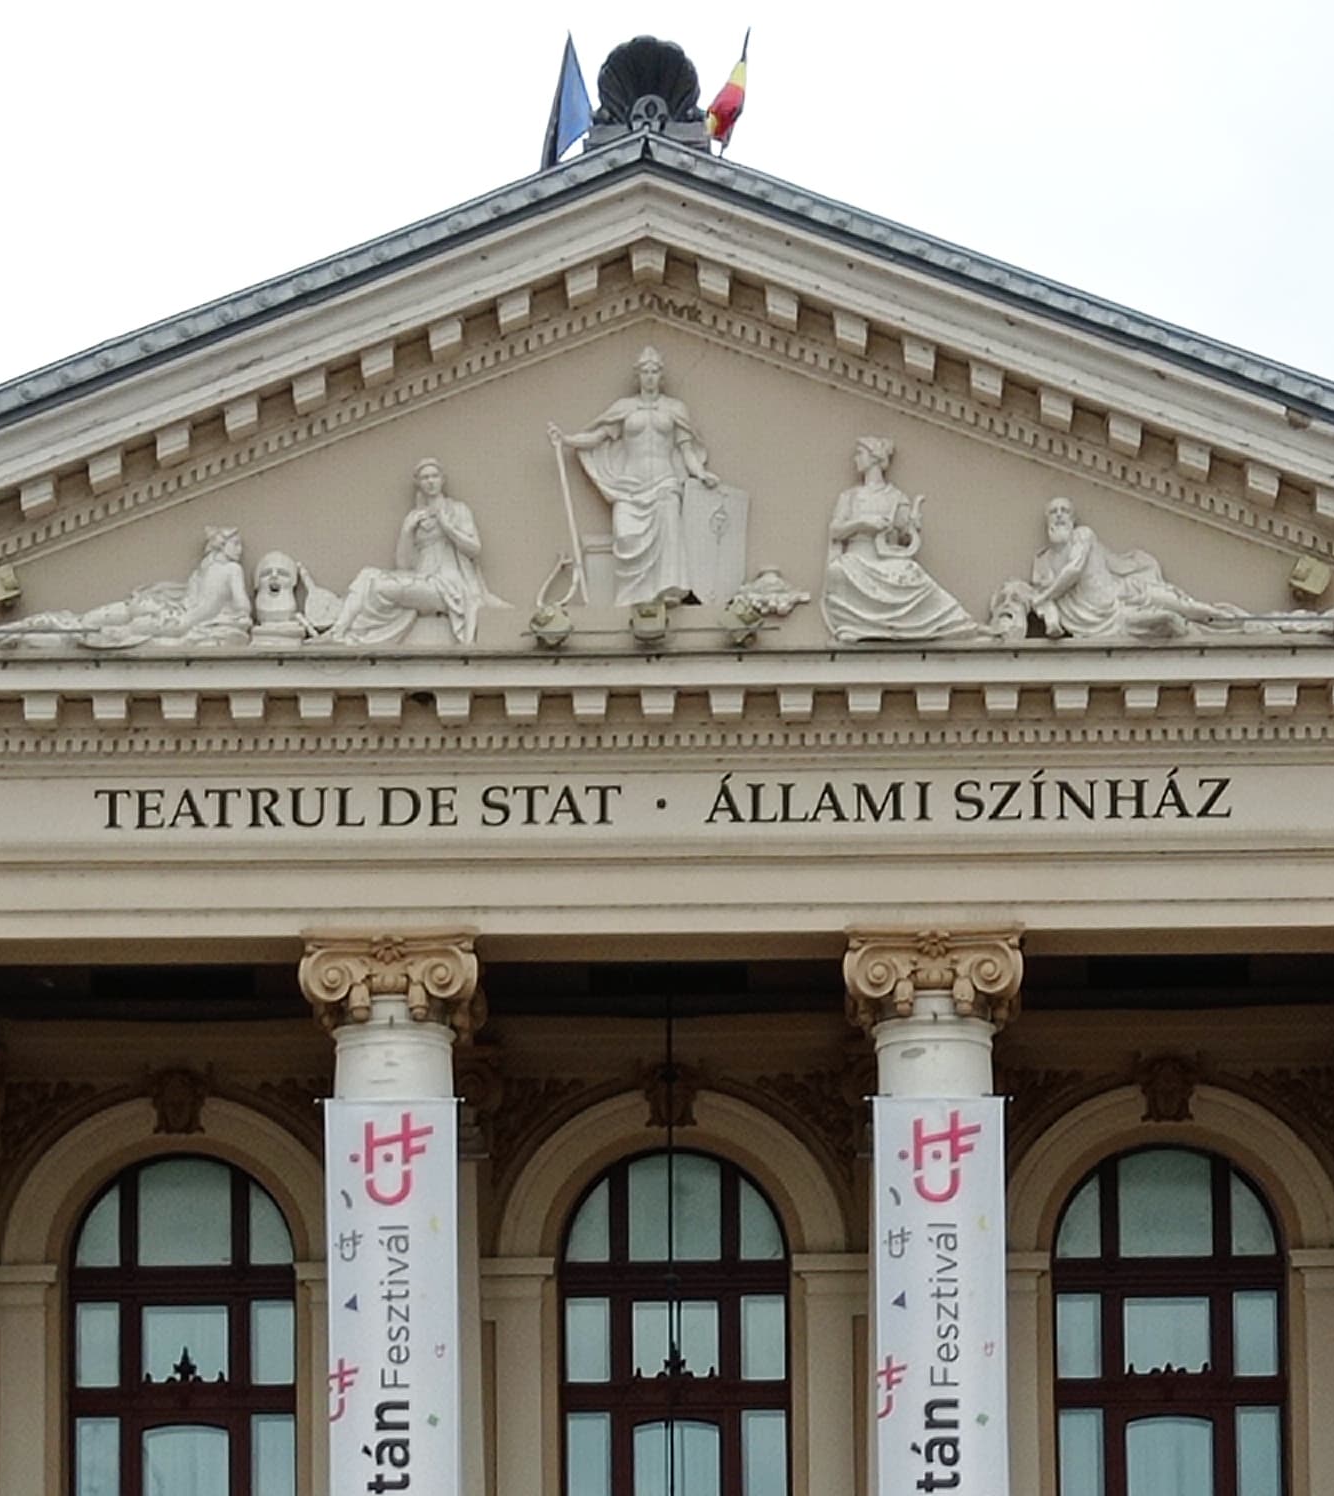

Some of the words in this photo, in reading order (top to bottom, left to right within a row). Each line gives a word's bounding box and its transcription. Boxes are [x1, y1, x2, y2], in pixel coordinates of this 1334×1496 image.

[94, 787, 366, 829] TEATRUL
[378, 786, 460, 827] DE
[480, 785, 623, 826] STAT
[705, 772, 935, 823] ÁLLAMI
[953, 768, 1233, 821] SZÍNHÁZ
[378, 1224, 410, 1389] Fesztivál
[928, 1222, 960, 1387] Fesztivál
